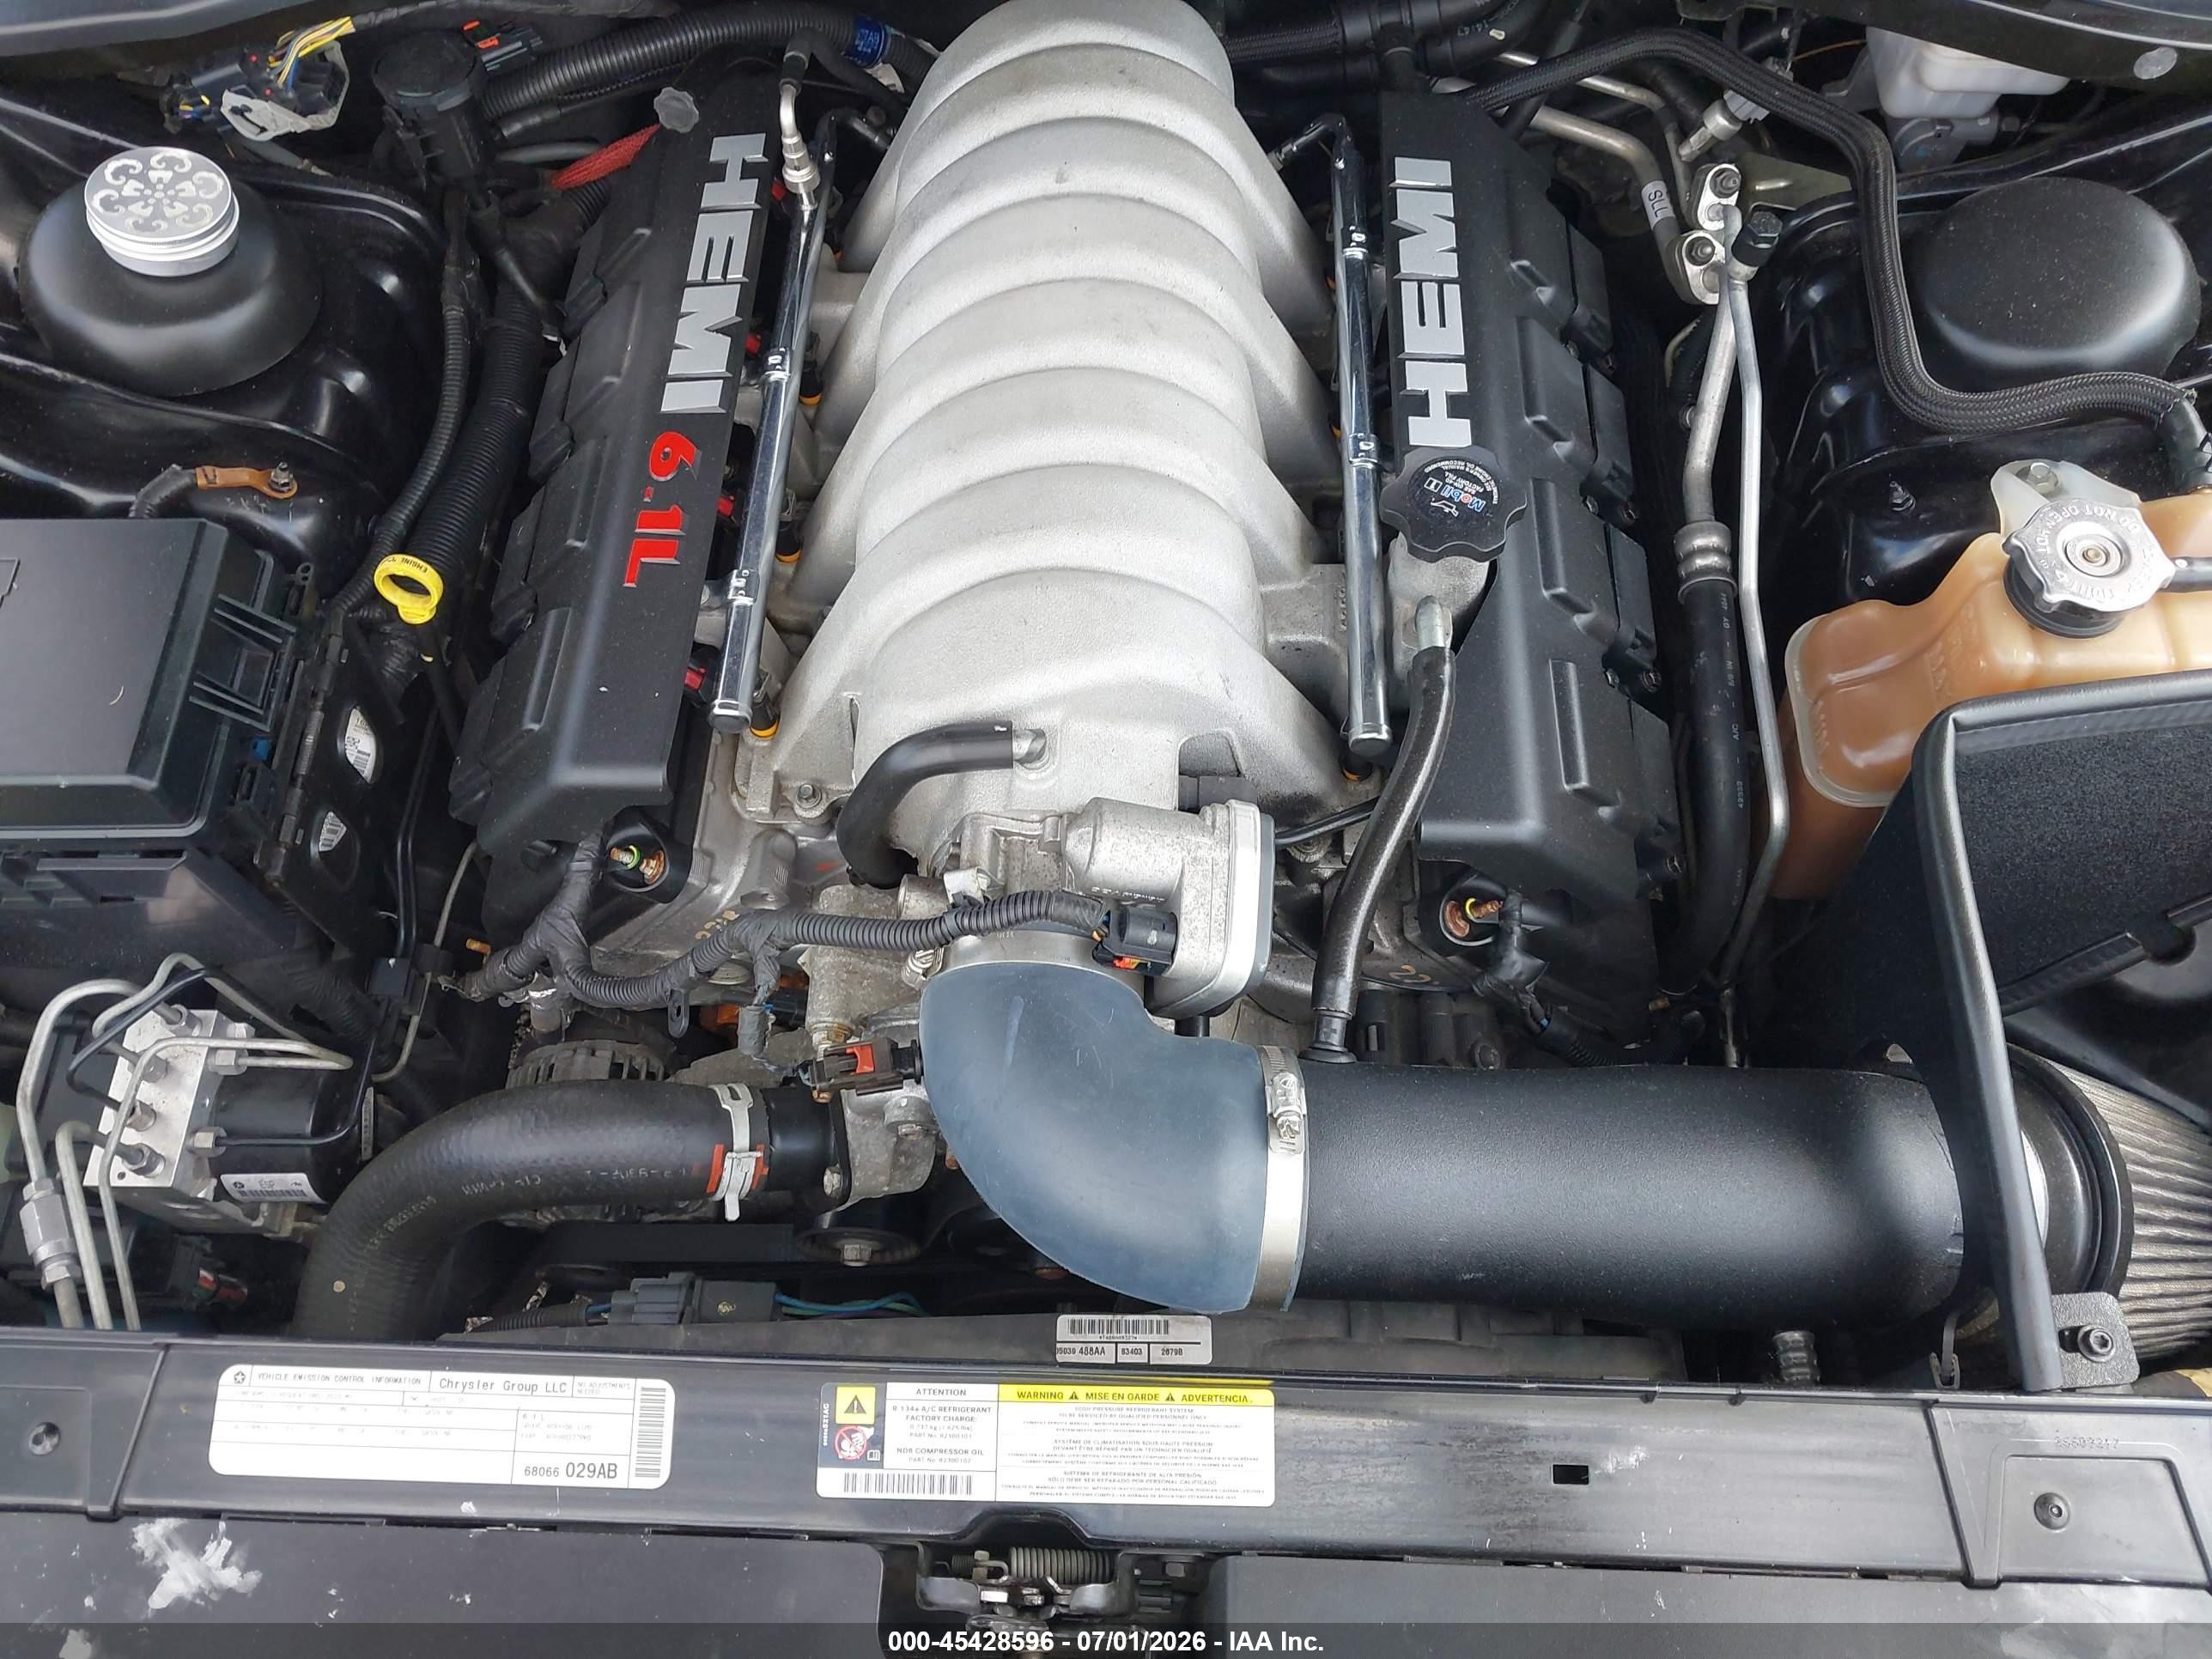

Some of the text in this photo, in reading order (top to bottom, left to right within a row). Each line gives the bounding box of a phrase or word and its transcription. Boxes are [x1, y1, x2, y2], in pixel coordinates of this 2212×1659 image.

[660, 131, 770, 414] HEMI
[1388, 156, 1473, 447] HEMI
[1444, 471, 1485, 492] FACTORY FILL
[1441, 484, 1486, 513] Mobil
[623, 430, 702, 588] 6.1L
[2044, 506, 2080, 529] OPEN
[2082, 504, 2117, 520] NOT
[2118, 516, 2141, 533] DO
[1731, 724, 1740, 741] A/C
[372, 1376, 421, 1385] INFORMATION
[439, 1378, 568, 1395] Chrysler Group LLC
[1017, 1391, 1064, 1400] WARNING
[1085, 1392, 1109, 1401] MISE
[1127, 1393, 1160, 1401] GARDE
[524, 1462, 617, 1479] 68066 029AB
